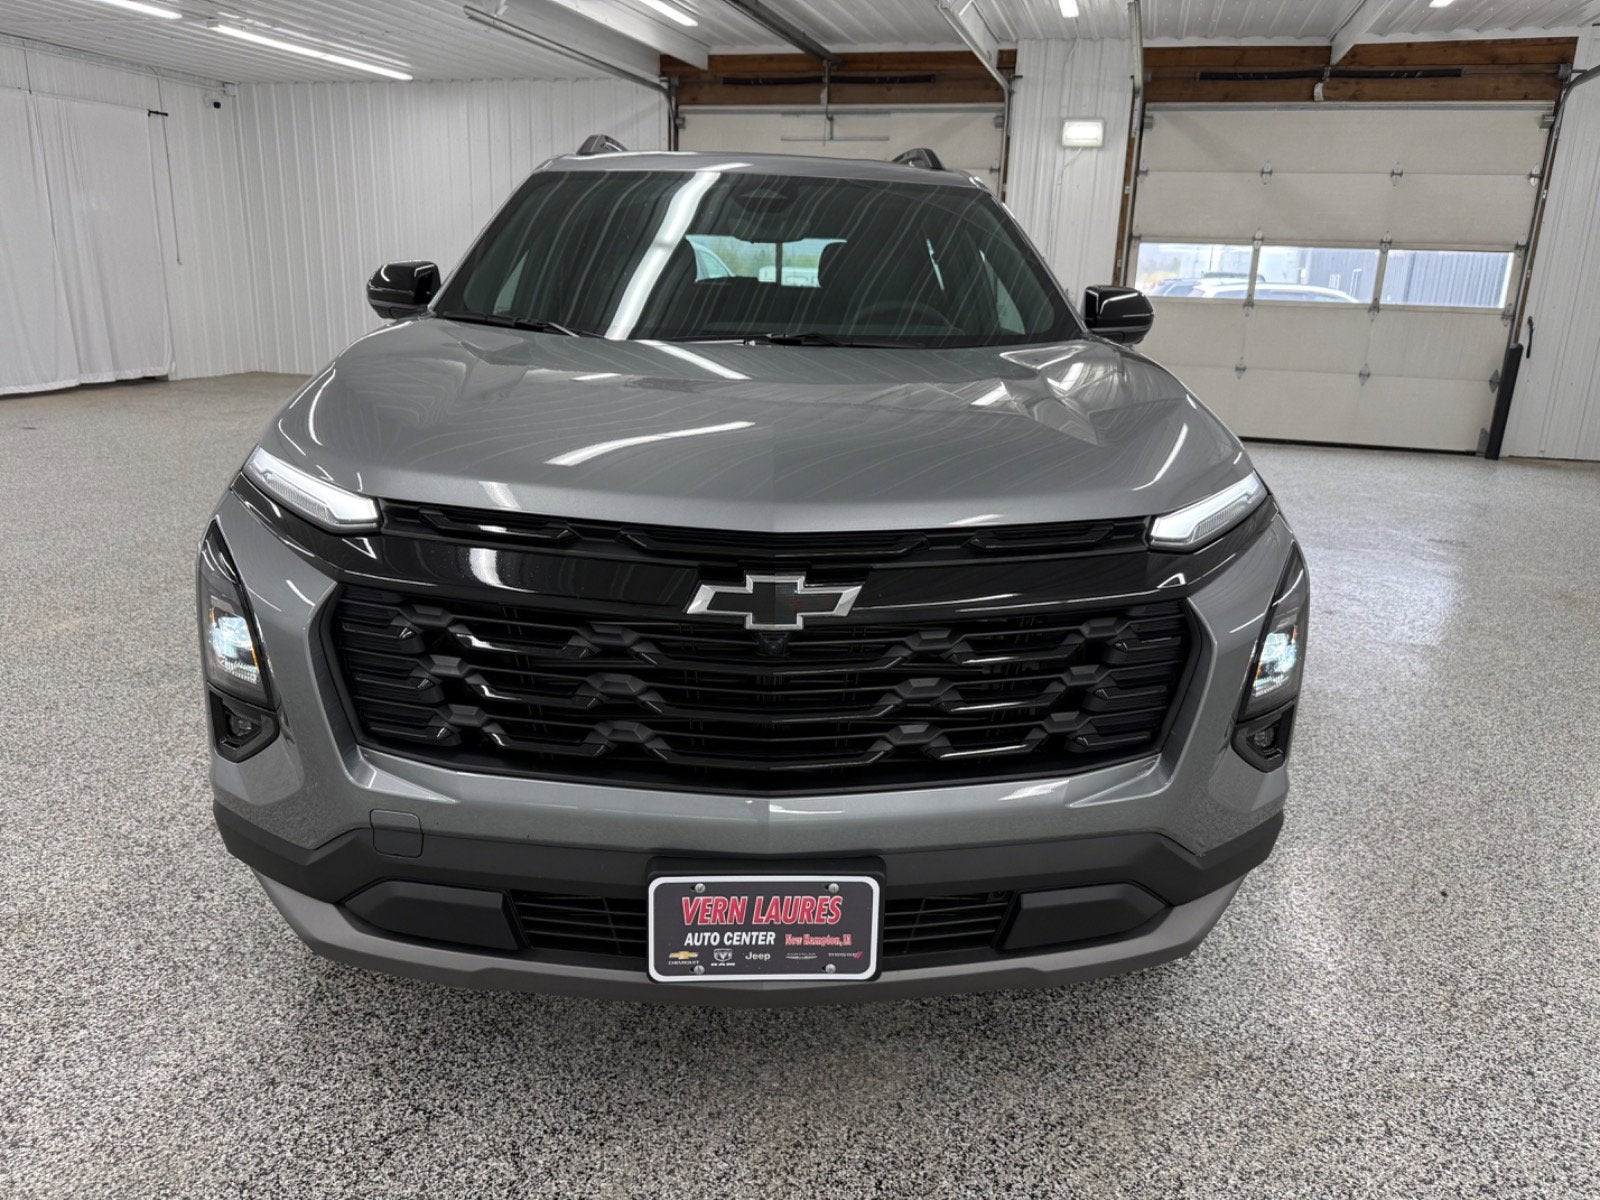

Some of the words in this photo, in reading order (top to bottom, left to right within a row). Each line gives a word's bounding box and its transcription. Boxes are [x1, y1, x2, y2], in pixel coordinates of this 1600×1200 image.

[681, 896, 748, 925] VERN
[752, 895, 843, 924] LAURES
[684, 933, 720, 946] AUTO
[724, 931, 776, 946] CENTER
[785, 934, 804, 946] New
[745, 951, 771, 960] Jeep
